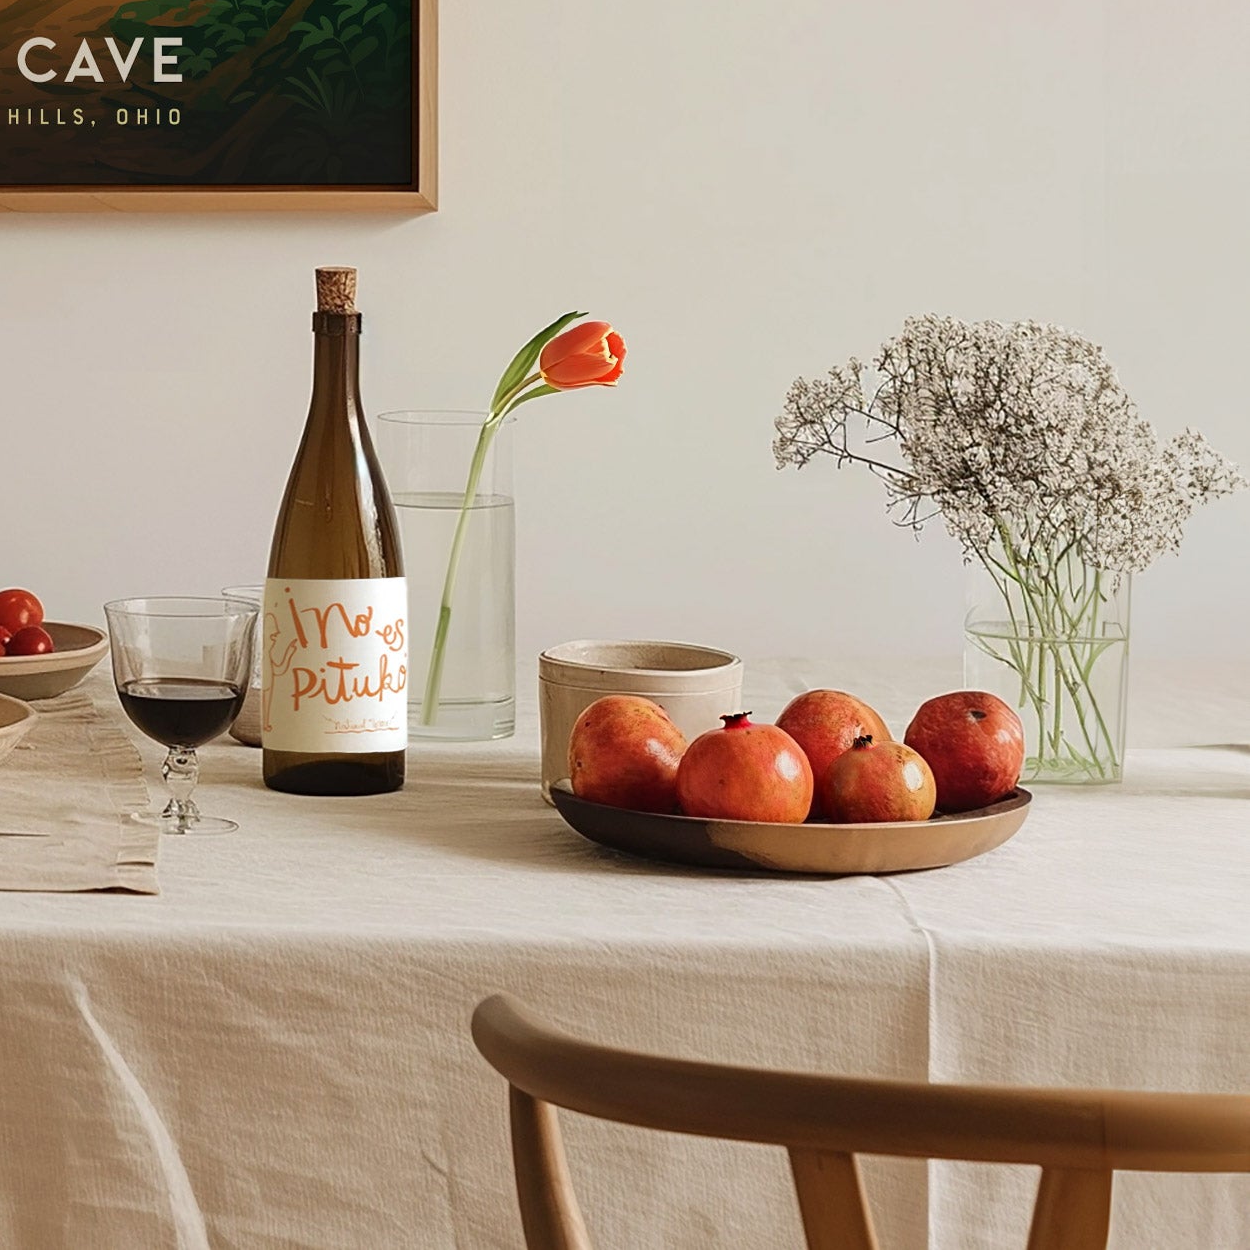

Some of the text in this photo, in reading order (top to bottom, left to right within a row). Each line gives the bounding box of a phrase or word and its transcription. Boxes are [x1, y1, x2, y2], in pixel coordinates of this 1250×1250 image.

[16, 36, 183, 83] CAVE
[7, 108, 96, 128] HILLS,
[116, 108, 181, 126] OHIO
